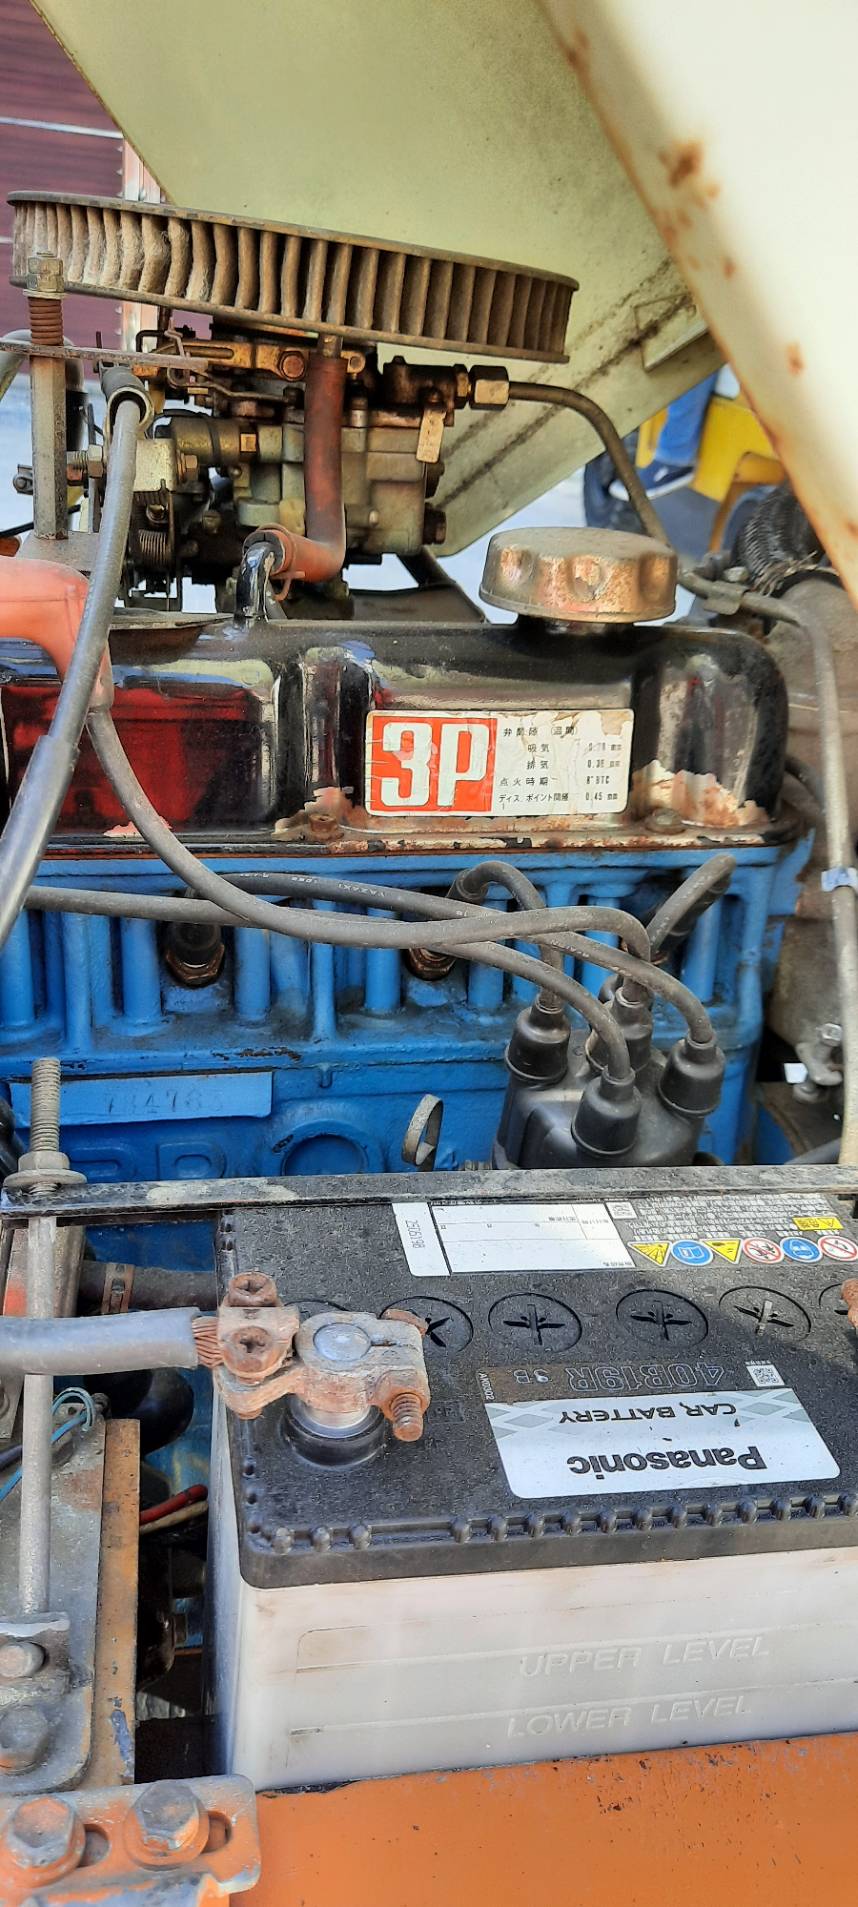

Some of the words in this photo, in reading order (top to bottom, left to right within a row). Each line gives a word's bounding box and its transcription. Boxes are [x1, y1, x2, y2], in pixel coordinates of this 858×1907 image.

[527, 743, 550, 753] 吸気
[381, 722, 489, 806] 3P
[499, 776, 549, 786] 点火時期
[585, 791, 603, 801] 0.45
[566, 1363, 724, 1392] 40B19R
[559, 1405, 675, 1423] BATTERY
[680, 1402, 737, 1417] CAR
[566, 1446, 768, 1480] Panasonic
[520, 1646, 643, 1677] UPPER
[662, 1636, 770, 1665] LEVEL
[507, 1706, 633, 1737] LOWER
[651, 1695, 751, 1721] LEVEL
